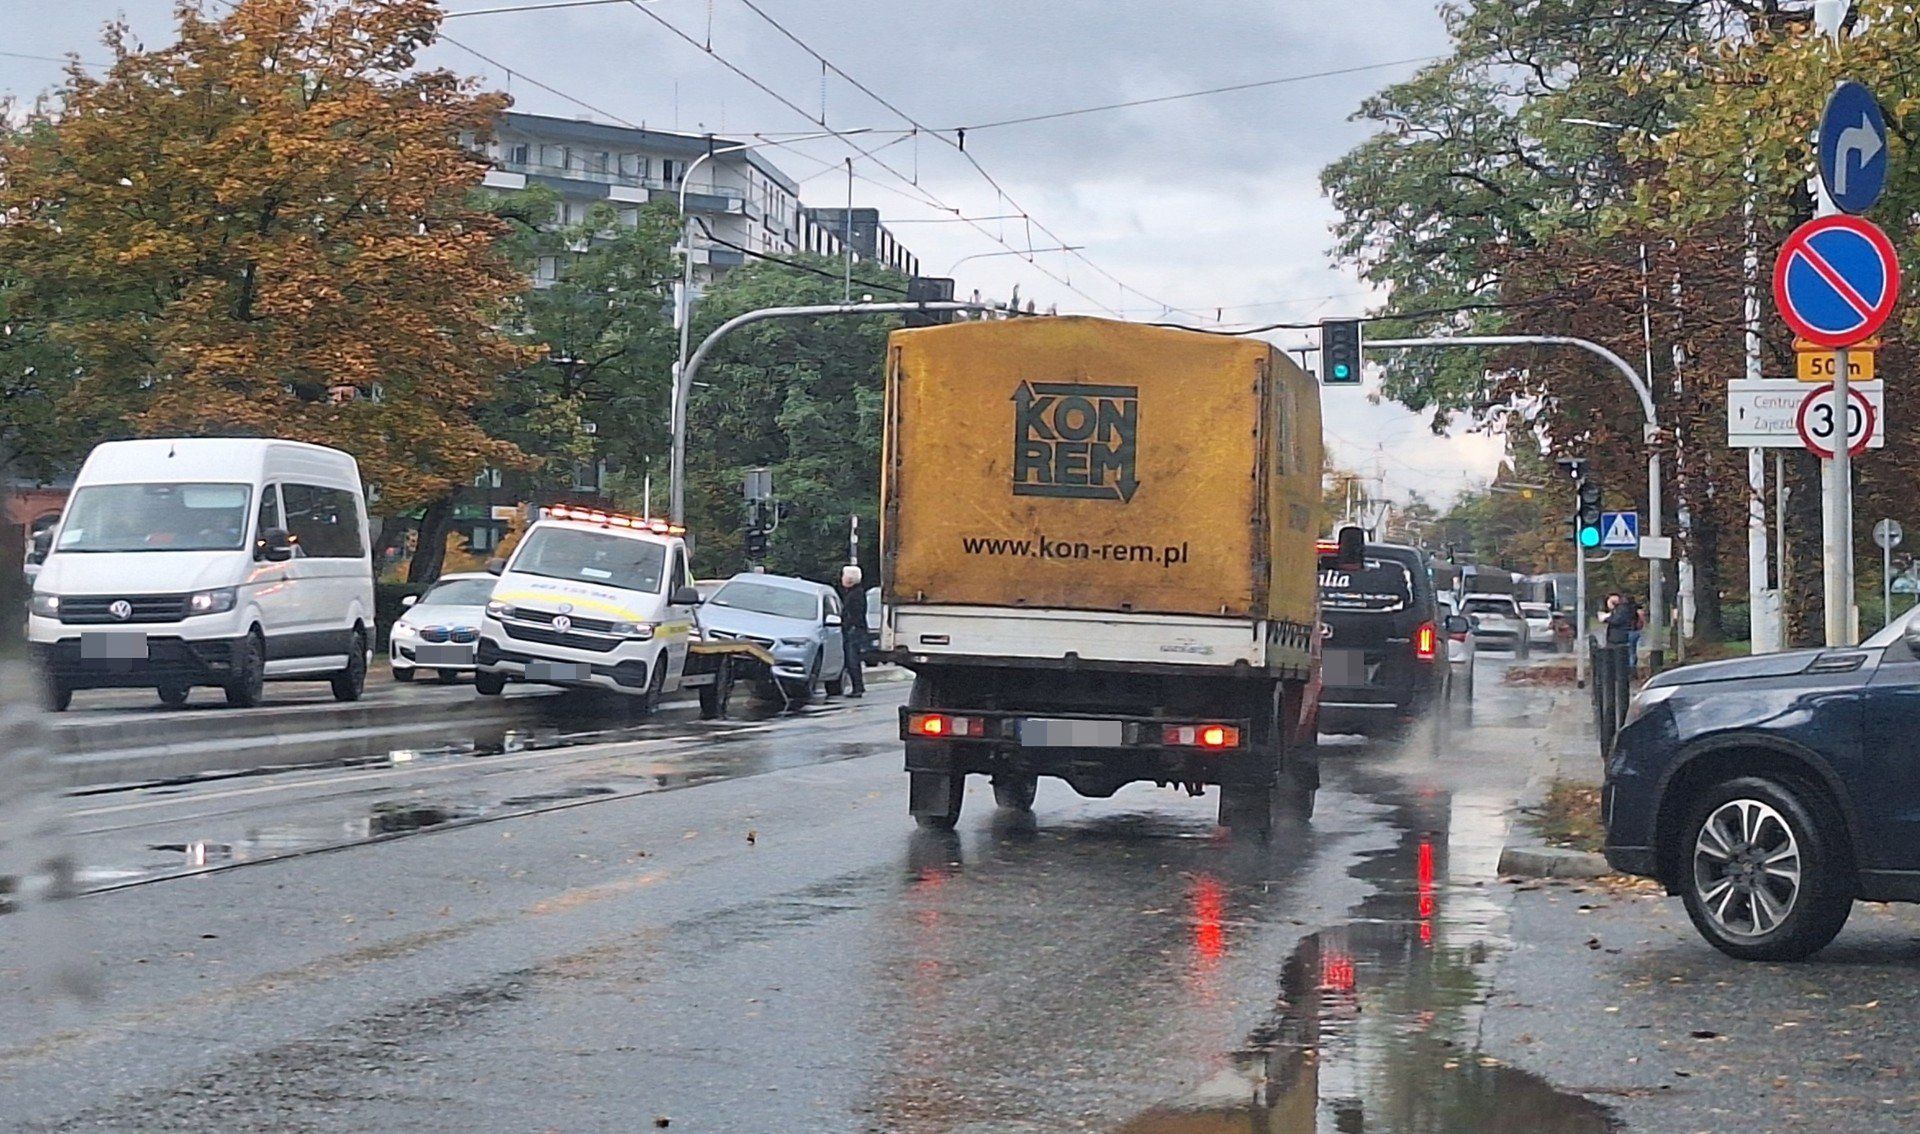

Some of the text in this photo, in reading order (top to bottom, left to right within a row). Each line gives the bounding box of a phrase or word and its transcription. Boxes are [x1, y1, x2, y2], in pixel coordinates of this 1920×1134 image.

[1015, 395, 1138, 442] KON
[1753, 395, 1802, 409] Centru
[1753, 416, 1794, 432] Zajezd
[1811, 403, 1863, 438] 30
[1014, 440, 1138, 487] REM
[962, 534, 1189, 568] www.kon-rem.pl
